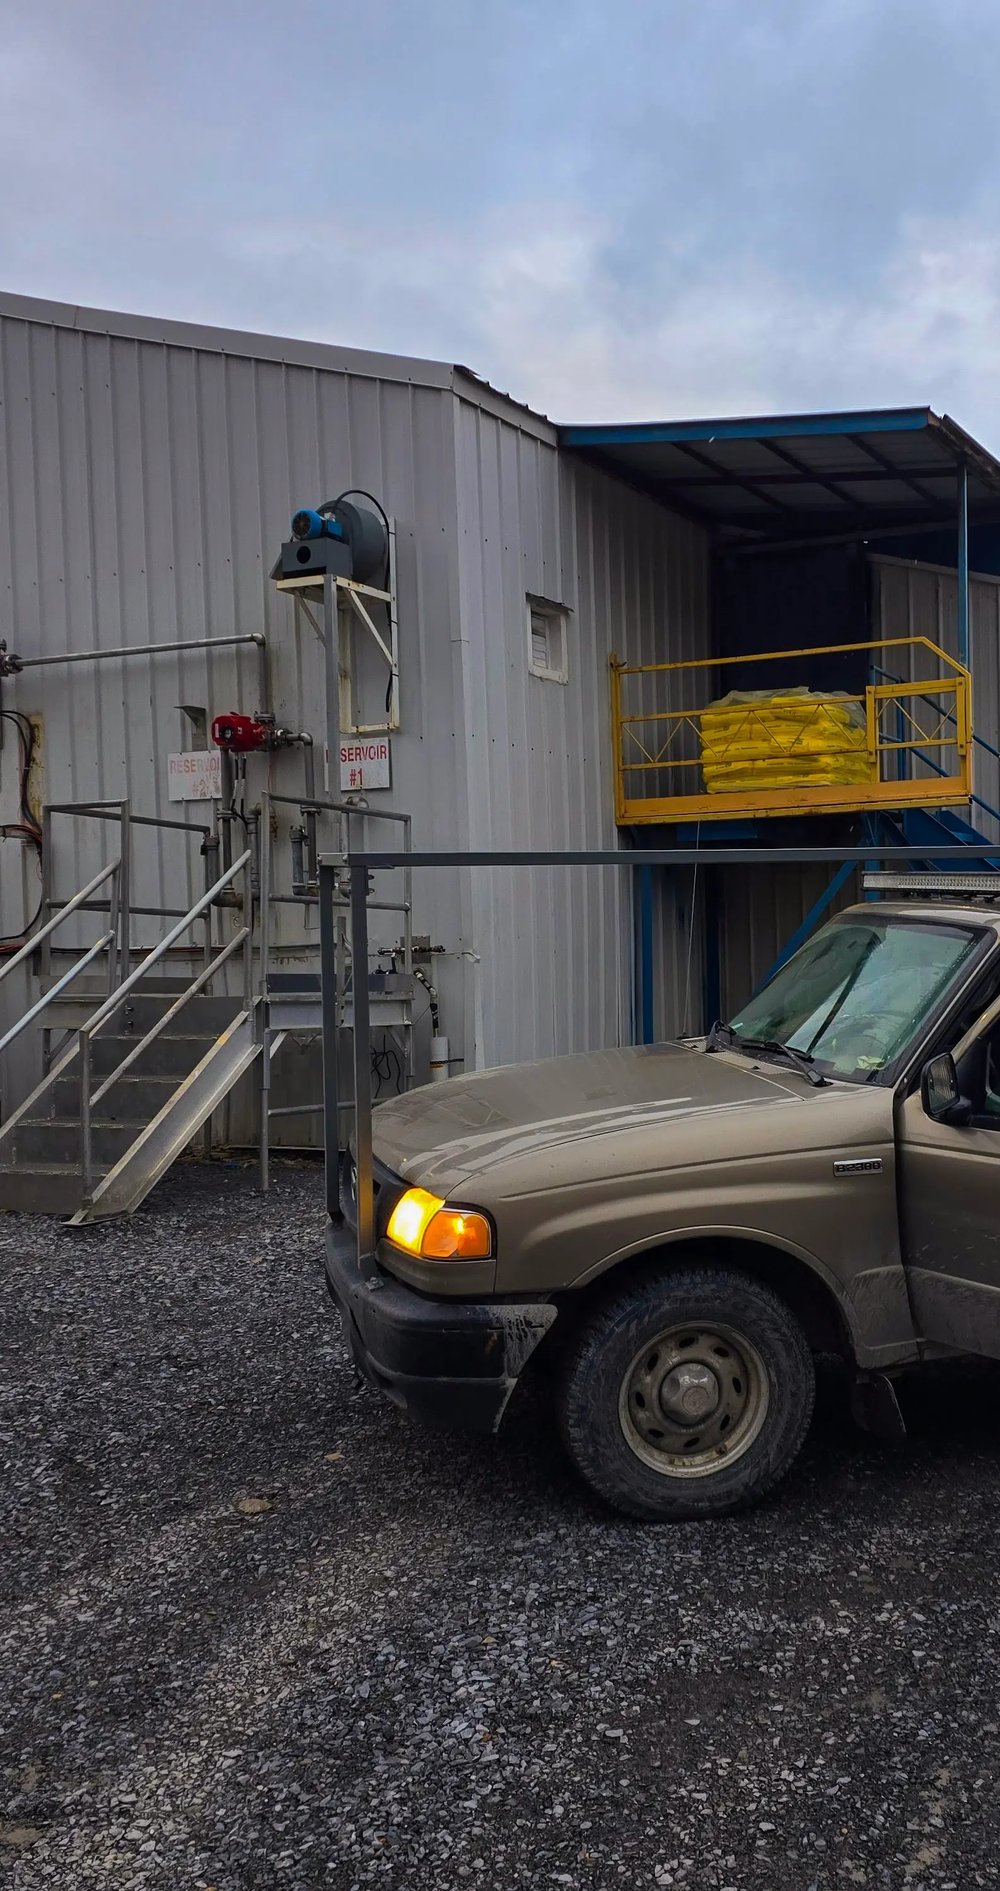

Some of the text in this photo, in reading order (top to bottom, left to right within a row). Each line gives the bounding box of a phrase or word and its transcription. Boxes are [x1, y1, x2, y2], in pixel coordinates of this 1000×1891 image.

[326, 745, 387, 763] SERVOIR
[349, 768, 363, 786] #1
[836, 1162, 881, 1173] B2300
